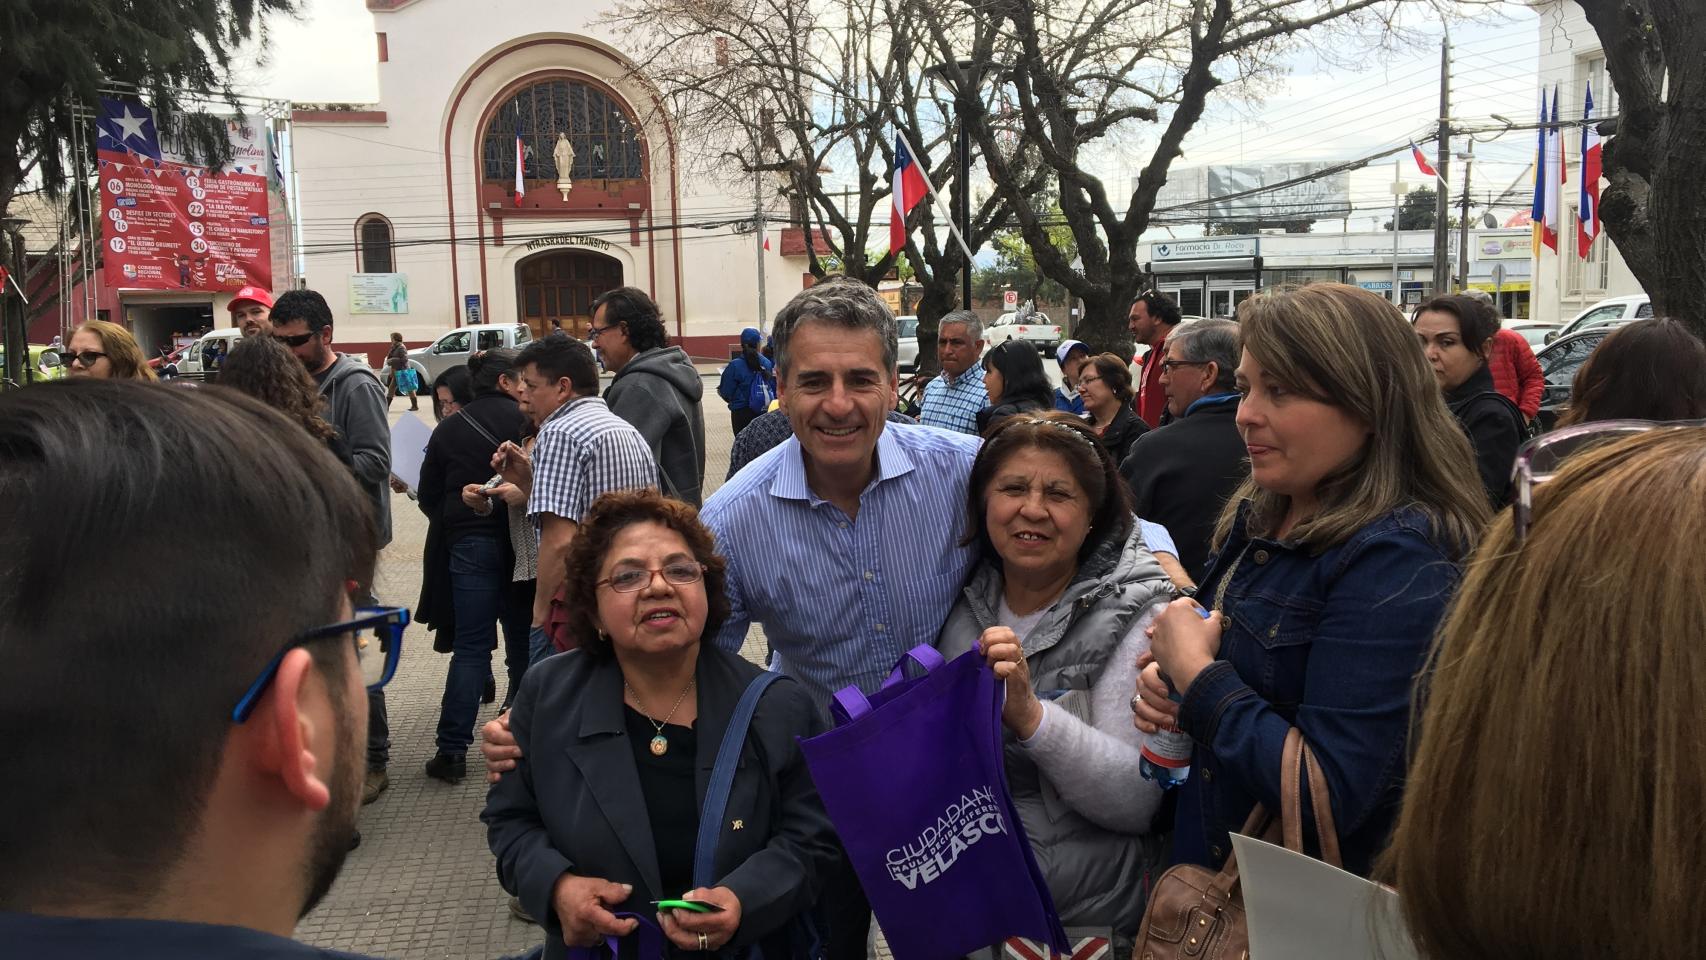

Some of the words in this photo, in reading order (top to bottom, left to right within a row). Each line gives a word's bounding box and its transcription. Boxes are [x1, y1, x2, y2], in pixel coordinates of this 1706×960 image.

[110, 182, 121, 191] 06
[190, 205, 202, 214] 22
[191, 224, 202, 233] 25
[113, 240, 123, 249] 12
[194, 241, 205, 250] 30
[1175, 243, 1210, 252] Farmacia
[886, 785, 998, 865] CIUDADAN
[892, 854, 929, 873] MAULE
[930, 825, 958, 855] DECIDE
